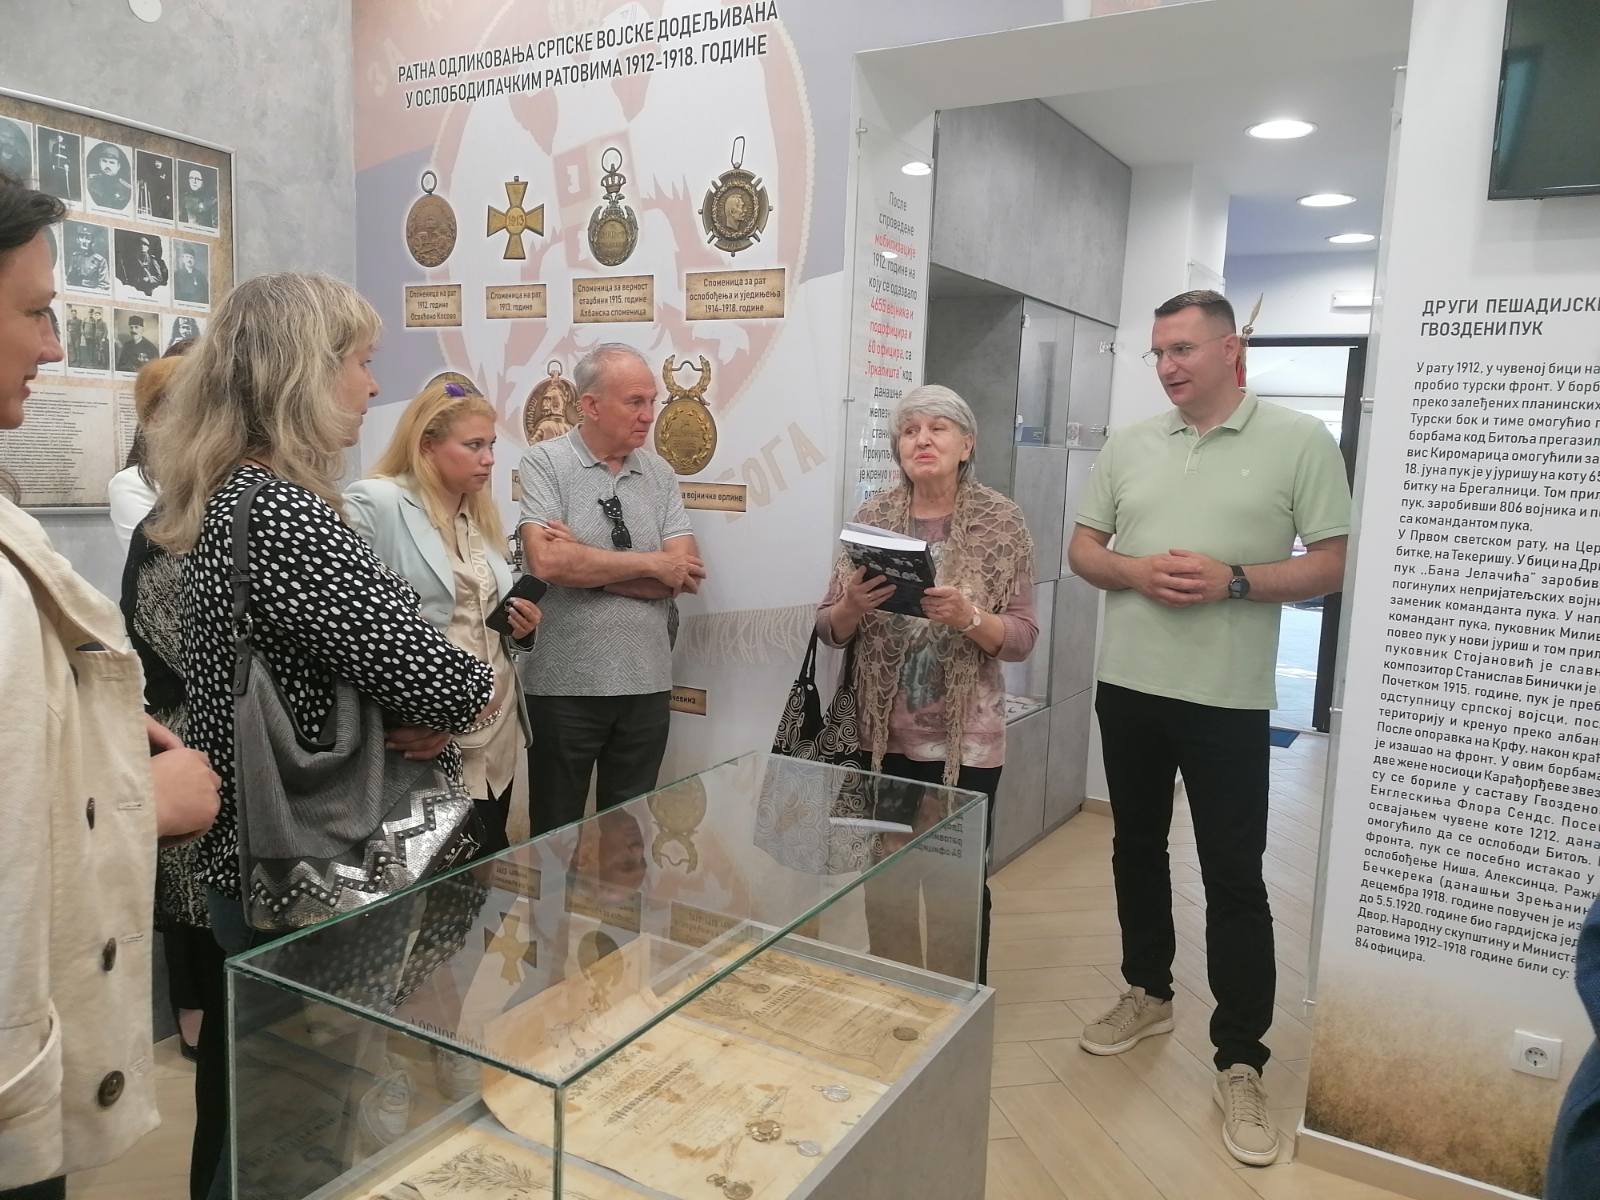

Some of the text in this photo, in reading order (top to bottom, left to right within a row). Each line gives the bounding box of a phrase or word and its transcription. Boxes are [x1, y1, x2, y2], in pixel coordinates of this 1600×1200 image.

[398, 0, 778, 83] РАТНА ОДЛИКОВАЊА СРПСКЕ ВОЈСКЕ ДОДЕЉИВАНА
[405, 34, 767, 109] У ОСЛОБОДИЛАЧКИМ РАТОВИМА 1912-1918. ГОДИНЕ
[889, 191, 908, 212] После
[577, 282, 648, 295] Споменица за верност
[703, 276, 766, 288] Споменица за рат
[624, 295, 647, 305] године
[689, 291, 733, 302] ослобођења
[739, 289, 781, 301] уједињења
[611, 307, 647, 318] споменица
[705, 302, 764, 314] 1914-1918. године
[1421, 298, 1479, 318] ДРУГИ
[1420, 320, 1544, 339] ГВОЗДЕНИ ПУК
[1416, 361, 1425, 373] У
[1425, 364, 1455, 376] рату
[1485, 364, 1494, 377] у
[1495, 361, 1546, 377] чувеној
[1548, 362, 1582, 376] бици
[1414, 378, 1459, 393] пробио
[1462, 381, 1506, 394] турски
[1508, 380, 1553, 395] фронт.
[1556, 380, 1566, 392] У
[1463, 433, 1486, 445] код
[1487, 431, 1537, 445] Битоља
[1403, 479, 1439, 495] битку
[1440, 483, 1456, 493] на
[1458, 481, 1540, 499] Брегалници.
[1543, 485, 1567, 499] Том
[1399, 515, 1414, 524] са
[1415, 516, 1498, 529] командантом
[1397, 528, 1407, 540] У
[1410, 529, 1449, 544] Првом
[1453, 535, 1512, 548] светском
[1553, 541, 1570, 552] на
[1389, 596, 1442, 609] заменик
[1445, 601, 1522, 617] команданта
[1526, 609, 1559, 621] пука.
[1564, 609, 1574, 622] У
[1388, 612, 1456, 627] командант
[1494, 622, 1556, 638] пуковник
[1381, 673, 1440, 691] Почетком
[1443, 681, 1471, 695] 1915.
[1526, 694, 1549, 707] пук
[1551, 694, 1565, 709] је
[1378, 707, 1445, 727] територију
[1449, 717, 1458, 727] и
[1462, 719, 1508, 735] кренуо
[1513, 726, 1552, 740] преко
[1373, 736, 1386, 750] је
[1388, 741, 1434, 756] изашао
[1436, 748, 1452, 758] на
[1455, 749, 1497, 766] фронт.
[1501, 755, 1510, 767] У
[1512, 759, 1544, 773] овим
[1371, 770, 1386, 783] су
[1390, 773, 1405, 784] се
[1410, 774, 1457, 792] бориле
[1462, 785, 1470, 796] у
[1475, 787, 1529, 806] саставу
[1368, 801, 1437, 821] освајањем
[1442, 814, 1489, 830] чувене
[1494, 823, 1524, 836] коте
[1362, 860, 1433, 884] Бечкерека
[1439, 875, 1510, 900] (данашњи
[1354, 936, 1426, 962] 84 официра.
[1356, 924, 1411, 943] ратовима
[1414, 934, 1467, 956] 1912-1918
[1470, 949, 1514, 966] године
[1516, 957, 1549, 974] били
